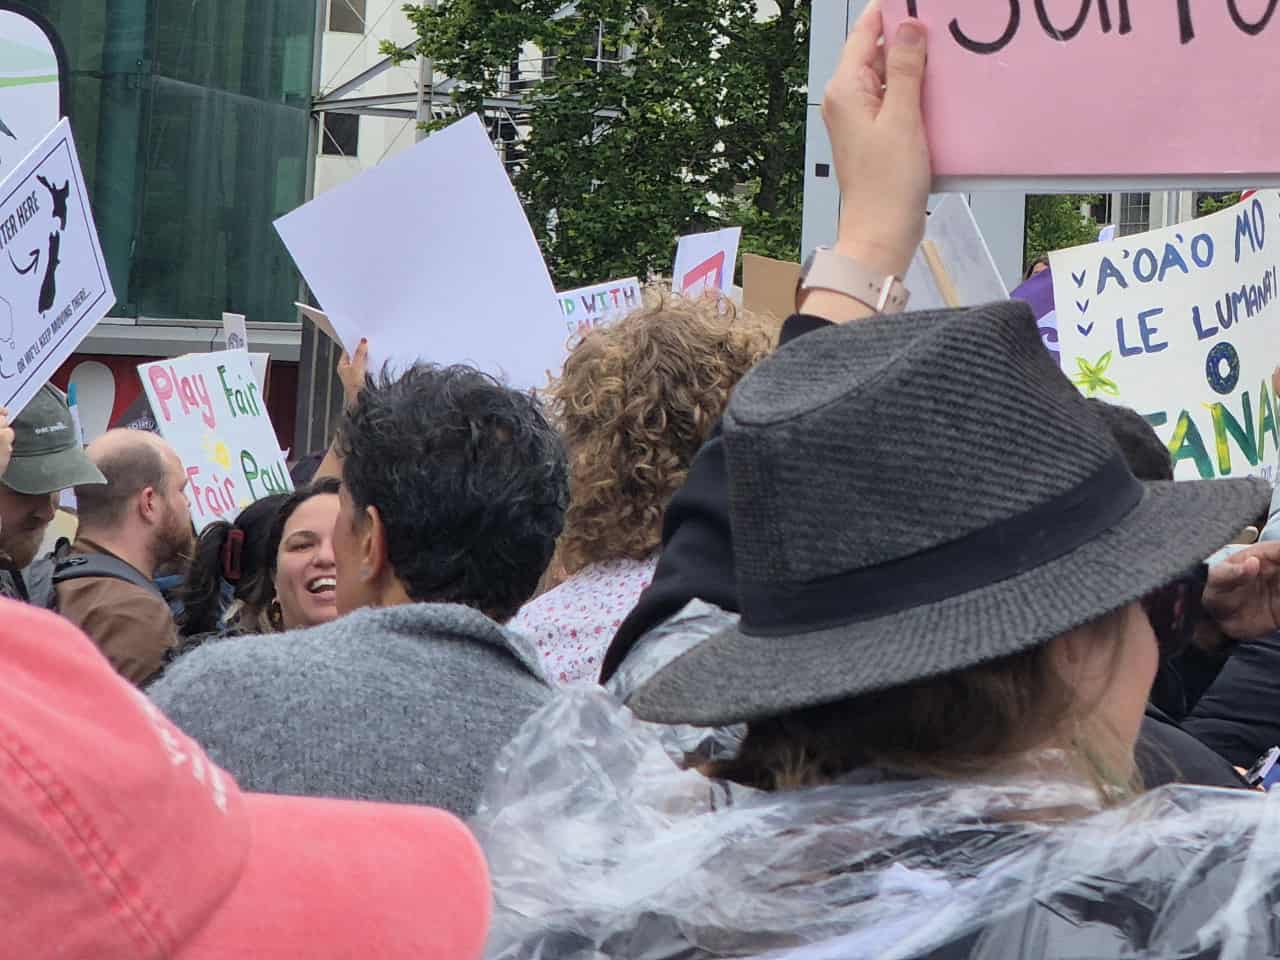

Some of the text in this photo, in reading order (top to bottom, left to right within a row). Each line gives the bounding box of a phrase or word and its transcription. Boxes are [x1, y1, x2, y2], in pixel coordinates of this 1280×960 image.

[16, 190, 40, 229] HERE
[1234, 198, 1265, 263] MO
[580, 285, 636, 314] WITH
[1115, 307, 1169, 358] LE
[1205, 341, 1241, 396] O
[148, 364, 261, 430] Play Fair
[186, 449, 289, 517] Fair Pay
